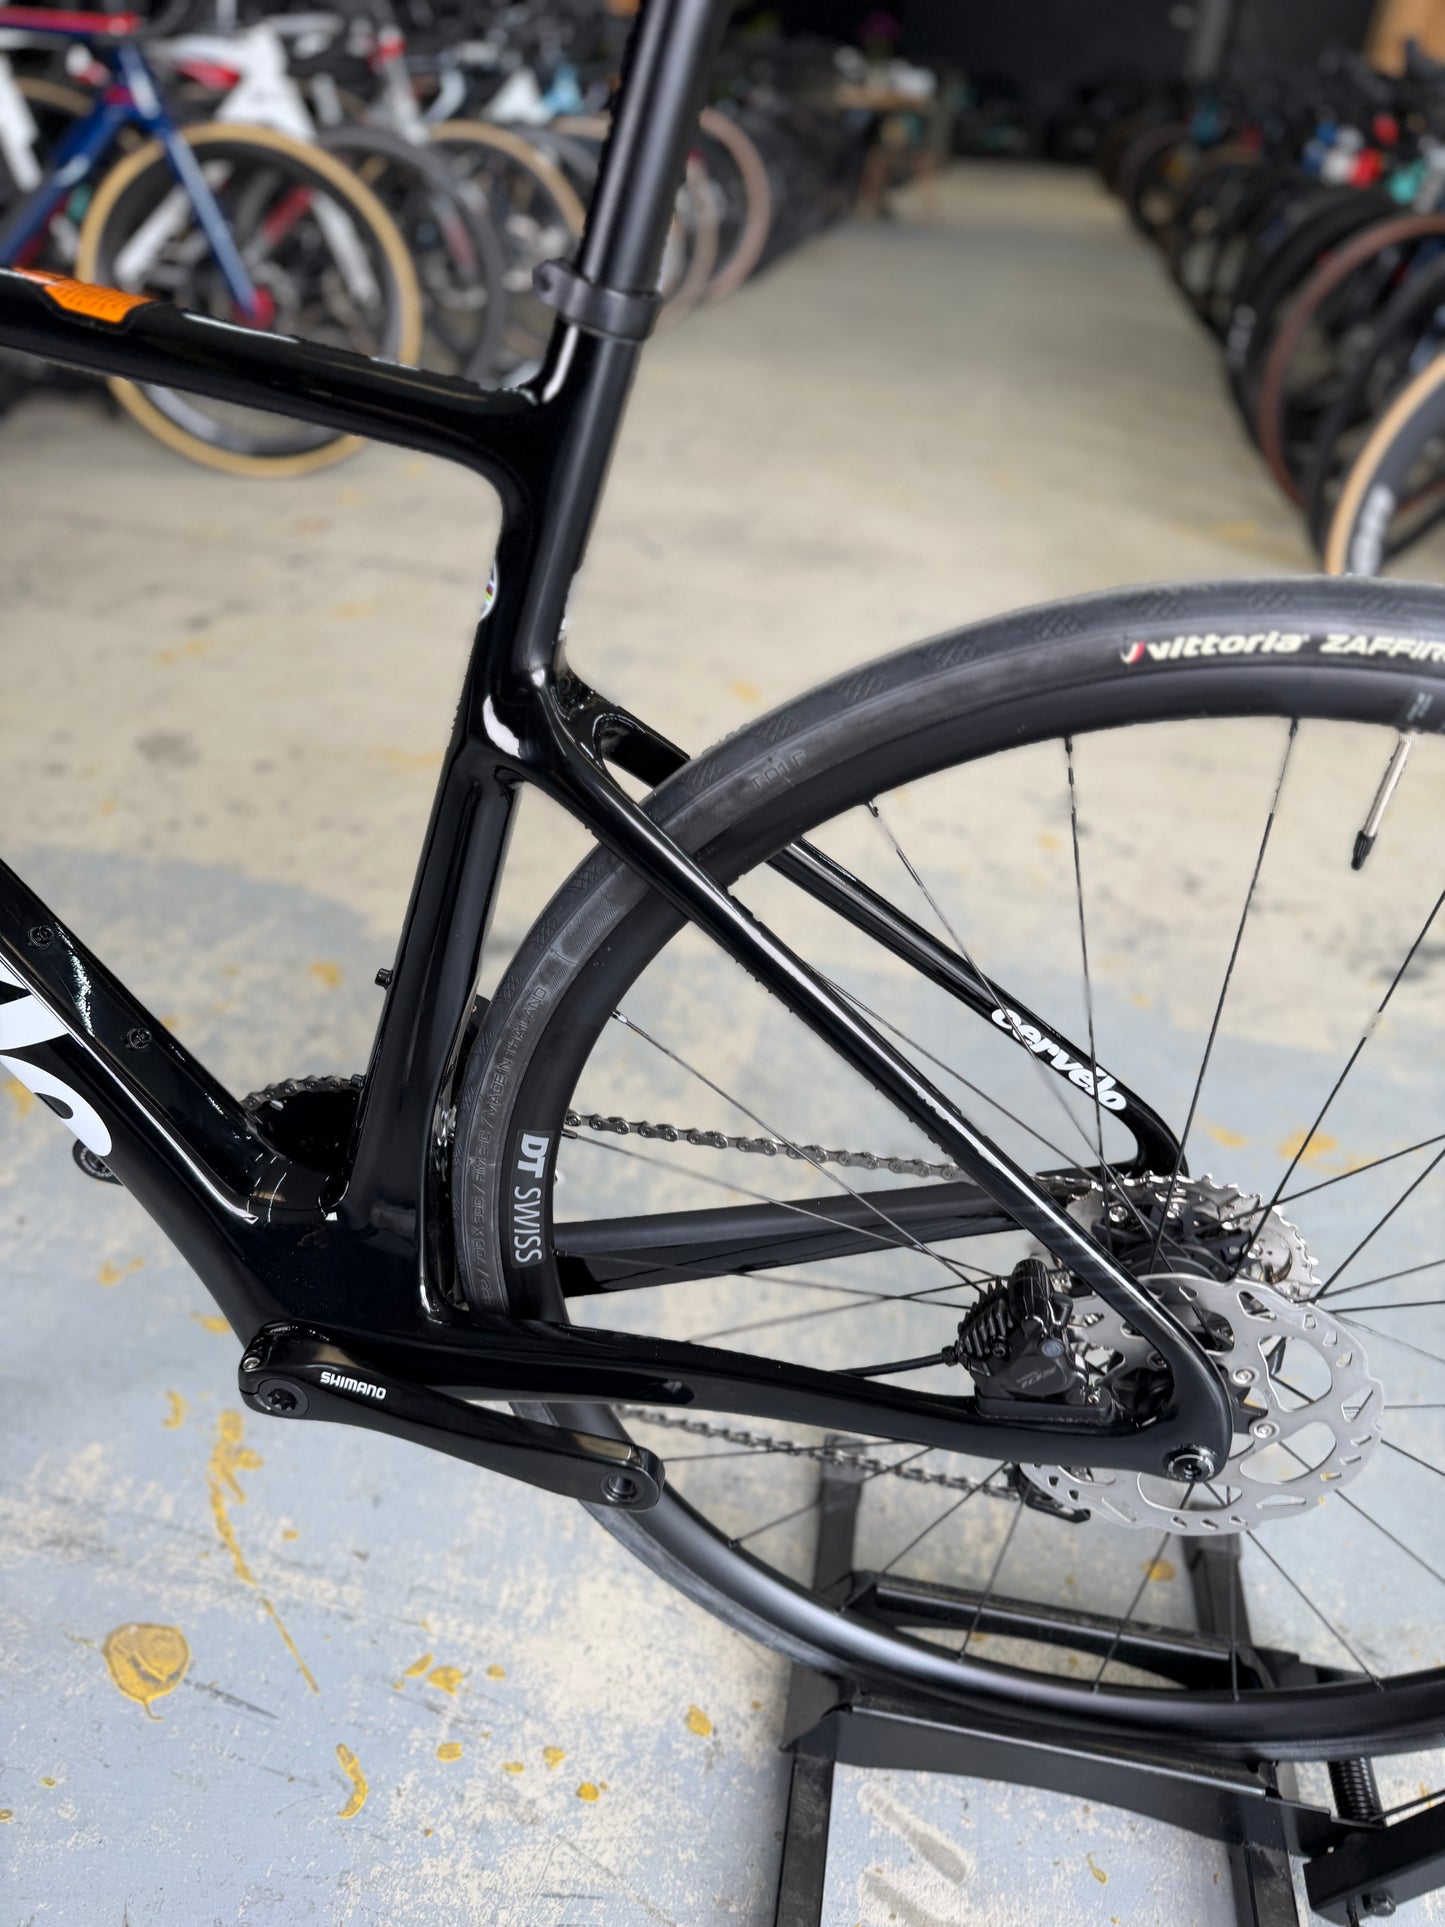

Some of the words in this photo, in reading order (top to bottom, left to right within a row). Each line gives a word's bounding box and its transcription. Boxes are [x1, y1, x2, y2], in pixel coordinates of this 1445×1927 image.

[1147, 630, 1305, 661] vittoria
[483, 1074, 507, 1118] MADE
[505, 986, 548, 1056] THAILAND
[517, 1133, 550, 1179] DT
[513, 1186, 543, 1263] SWISS
[319, 1371, 387, 1401] SHIMANO
